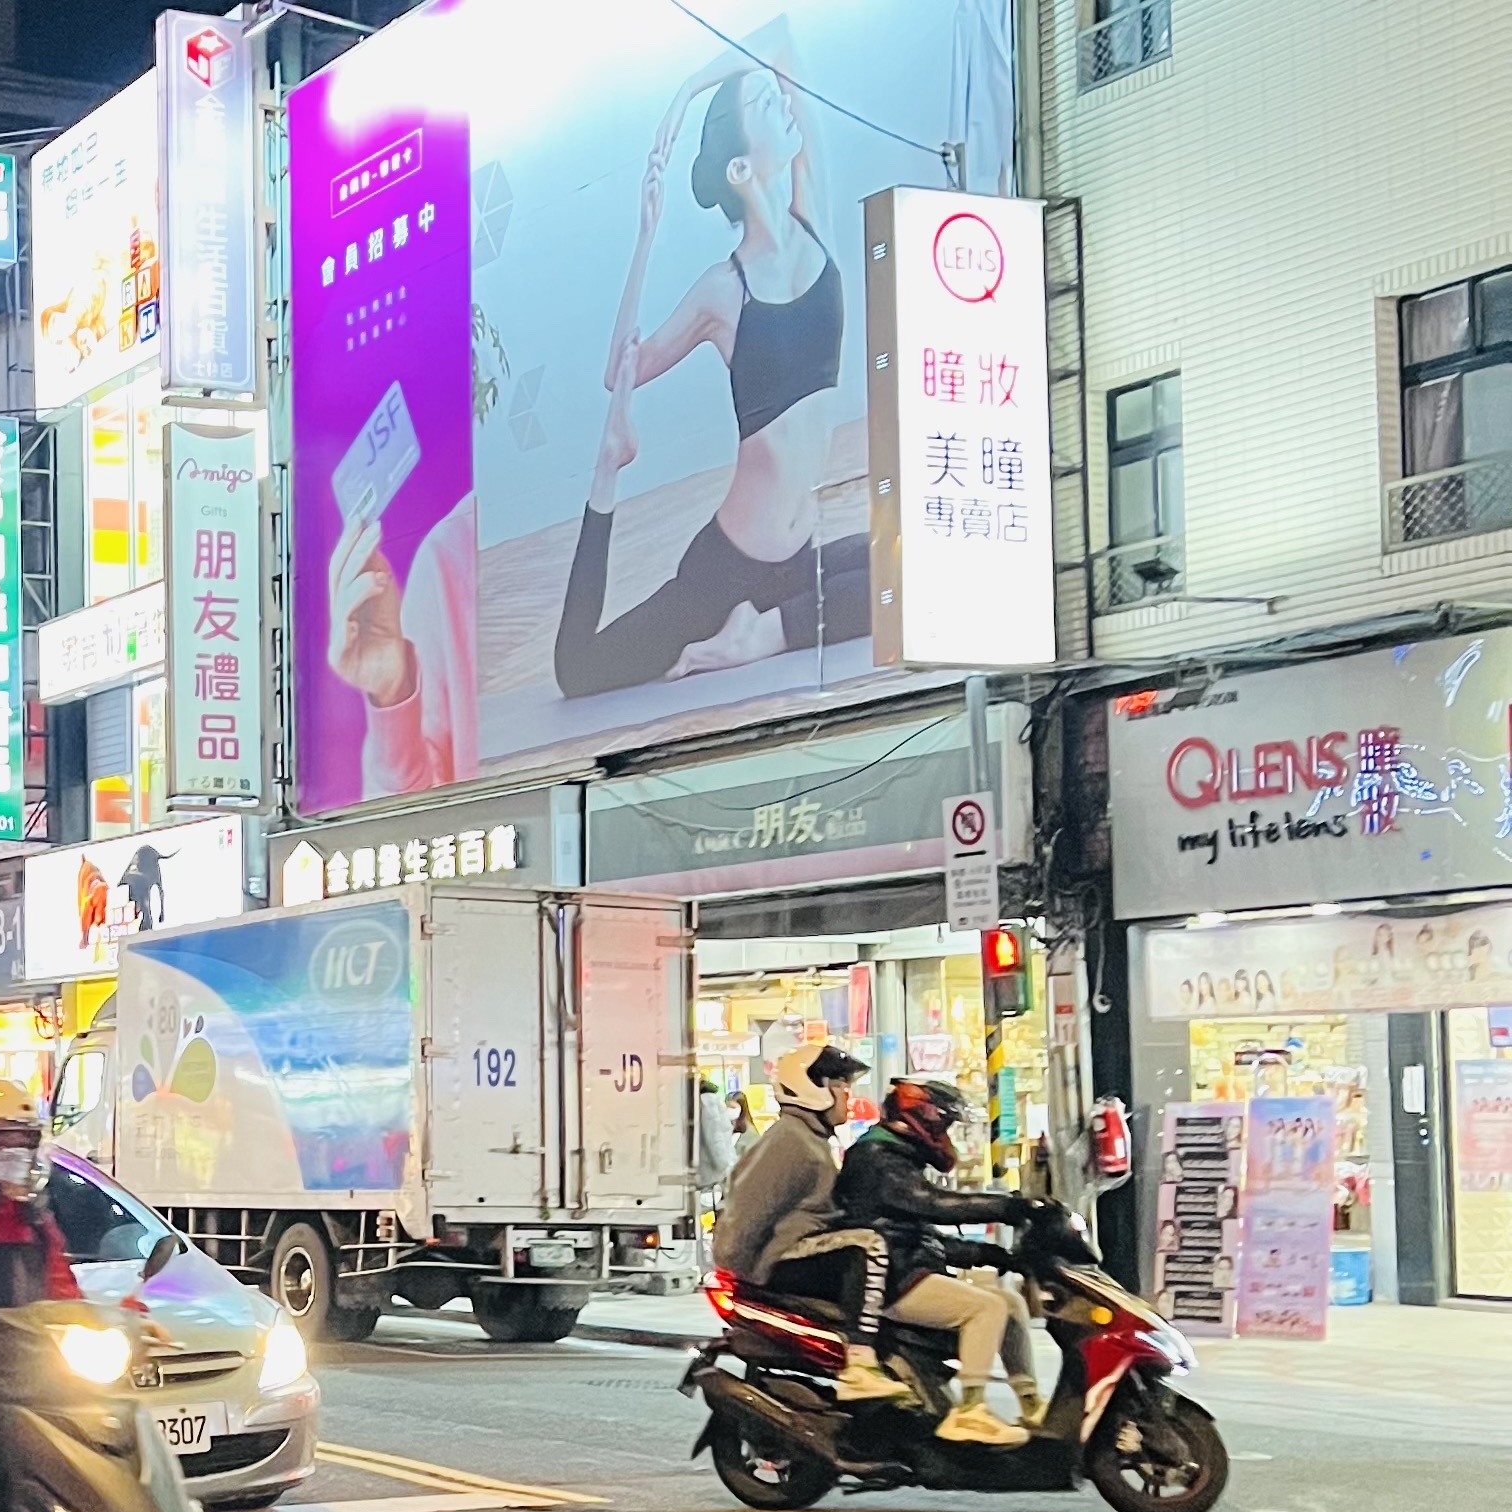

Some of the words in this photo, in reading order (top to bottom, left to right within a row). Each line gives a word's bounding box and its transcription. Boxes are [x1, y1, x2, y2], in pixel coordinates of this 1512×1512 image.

[321, 201, 435, 287] 會員招募中
[923, 347, 1020, 408] 瞳妝
[366, 390, 401, 468] JSF
[176, 457, 254, 494] Amigo
[925, 430, 1025, 491] 美瞳
[200, 505, 228, 518] Gifts
[923, 495, 1029, 543] 專賣店
[192, 529, 242, 761] 朋友禮品
[472, 1047, 517, 1088] 192
